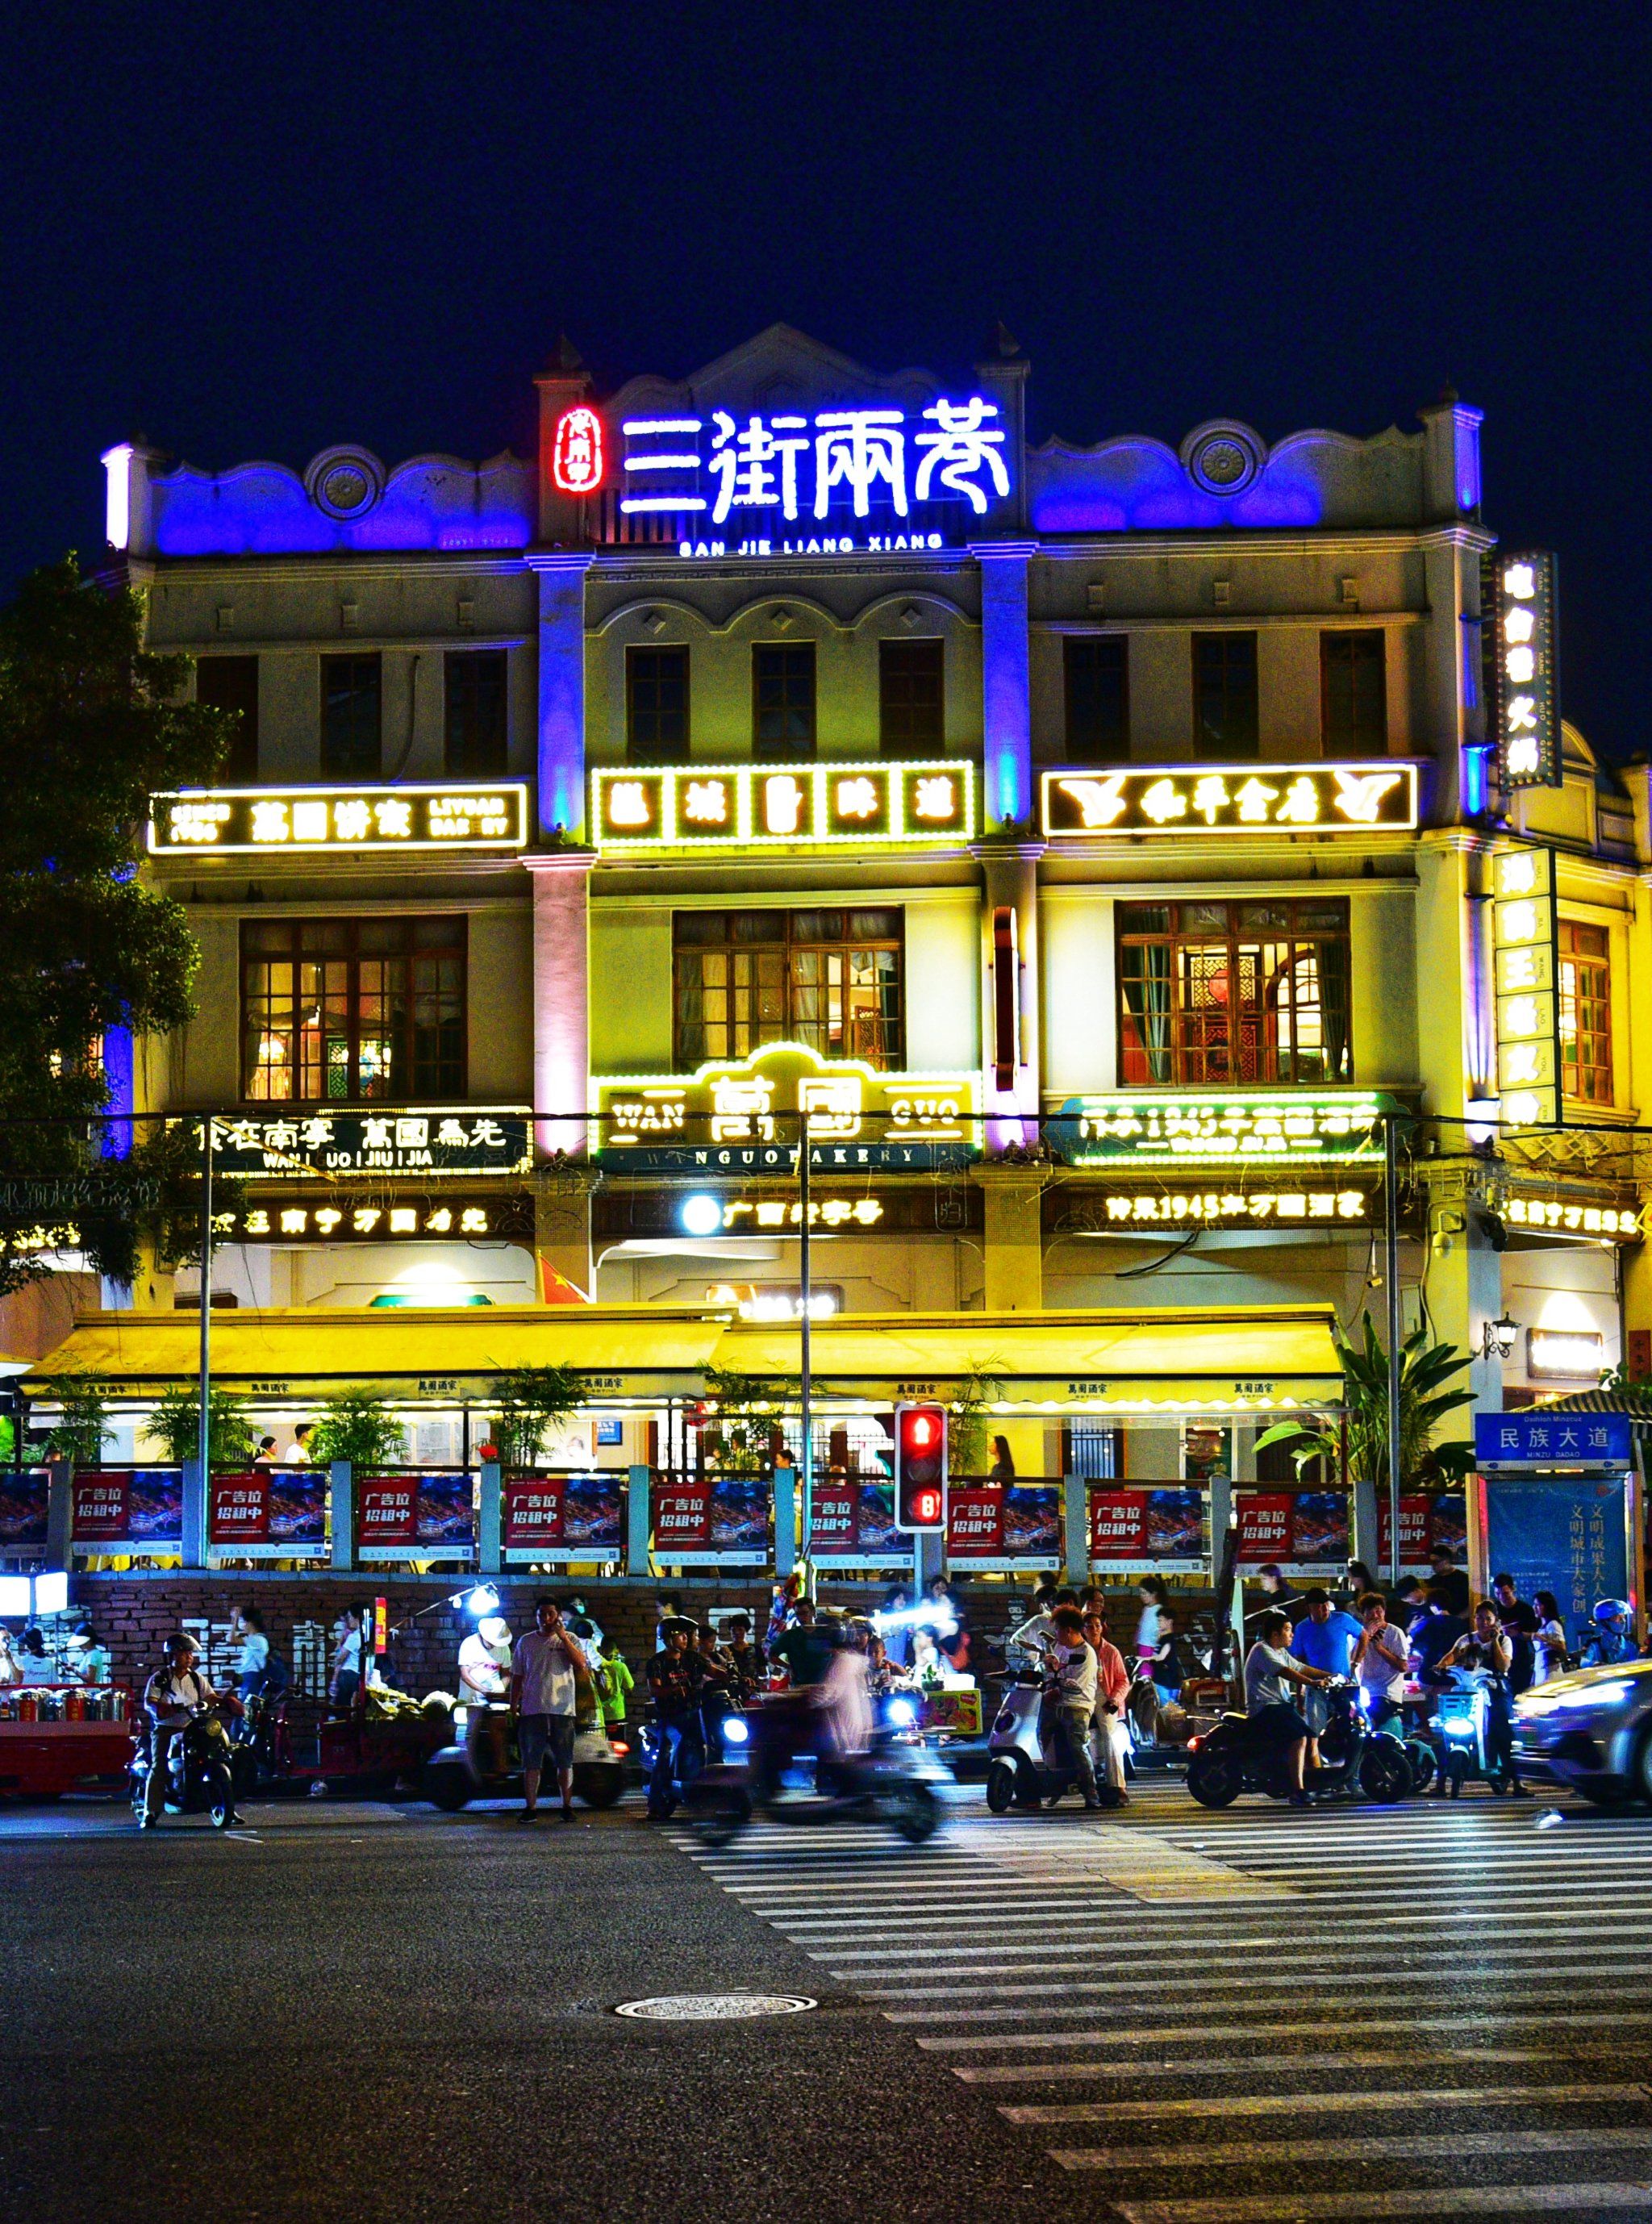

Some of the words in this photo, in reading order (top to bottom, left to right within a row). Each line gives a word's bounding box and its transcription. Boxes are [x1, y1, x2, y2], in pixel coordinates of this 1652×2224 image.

[679, 541, 725, 557] SAN
[738, 540, 771, 556] JIE
[783, 537, 853, 555] LIANG
[868, 533, 943, 551] XIANG
[611, 1103, 686, 1129] WAN
[890, 1099, 958, 1125] GUO
[1500, 1426, 1608, 1449] 民族大道
[77, 1488, 122, 1500] 广告位
[217, 1490, 261, 1504] 广告位
[365, 1493, 410, 1505] 广告位
[512, 1494, 557, 1508] 广告位
[78, 1504, 123, 1517] 招租中
[659, 1497, 704, 1512] 广告位
[952, 1504, 997, 1517] 广告位
[217, 1507, 263, 1521] 招租中
[365, 1509, 411, 1522] 招租中
[512, 1511, 557, 1525] 招租中
[1096, 1506, 1141, 1519] 广告位
[1241, 1509, 1286, 1523] 广告位
[660, 1514, 704, 1528] 招租中
[953, 1521, 998, 1533] 招租中
[1097, 1522, 1141, 1535] 招租中
[1242, 1526, 1287, 1540] 招租中
[1589, 1504, 1606, 1605] 文明成果人人
